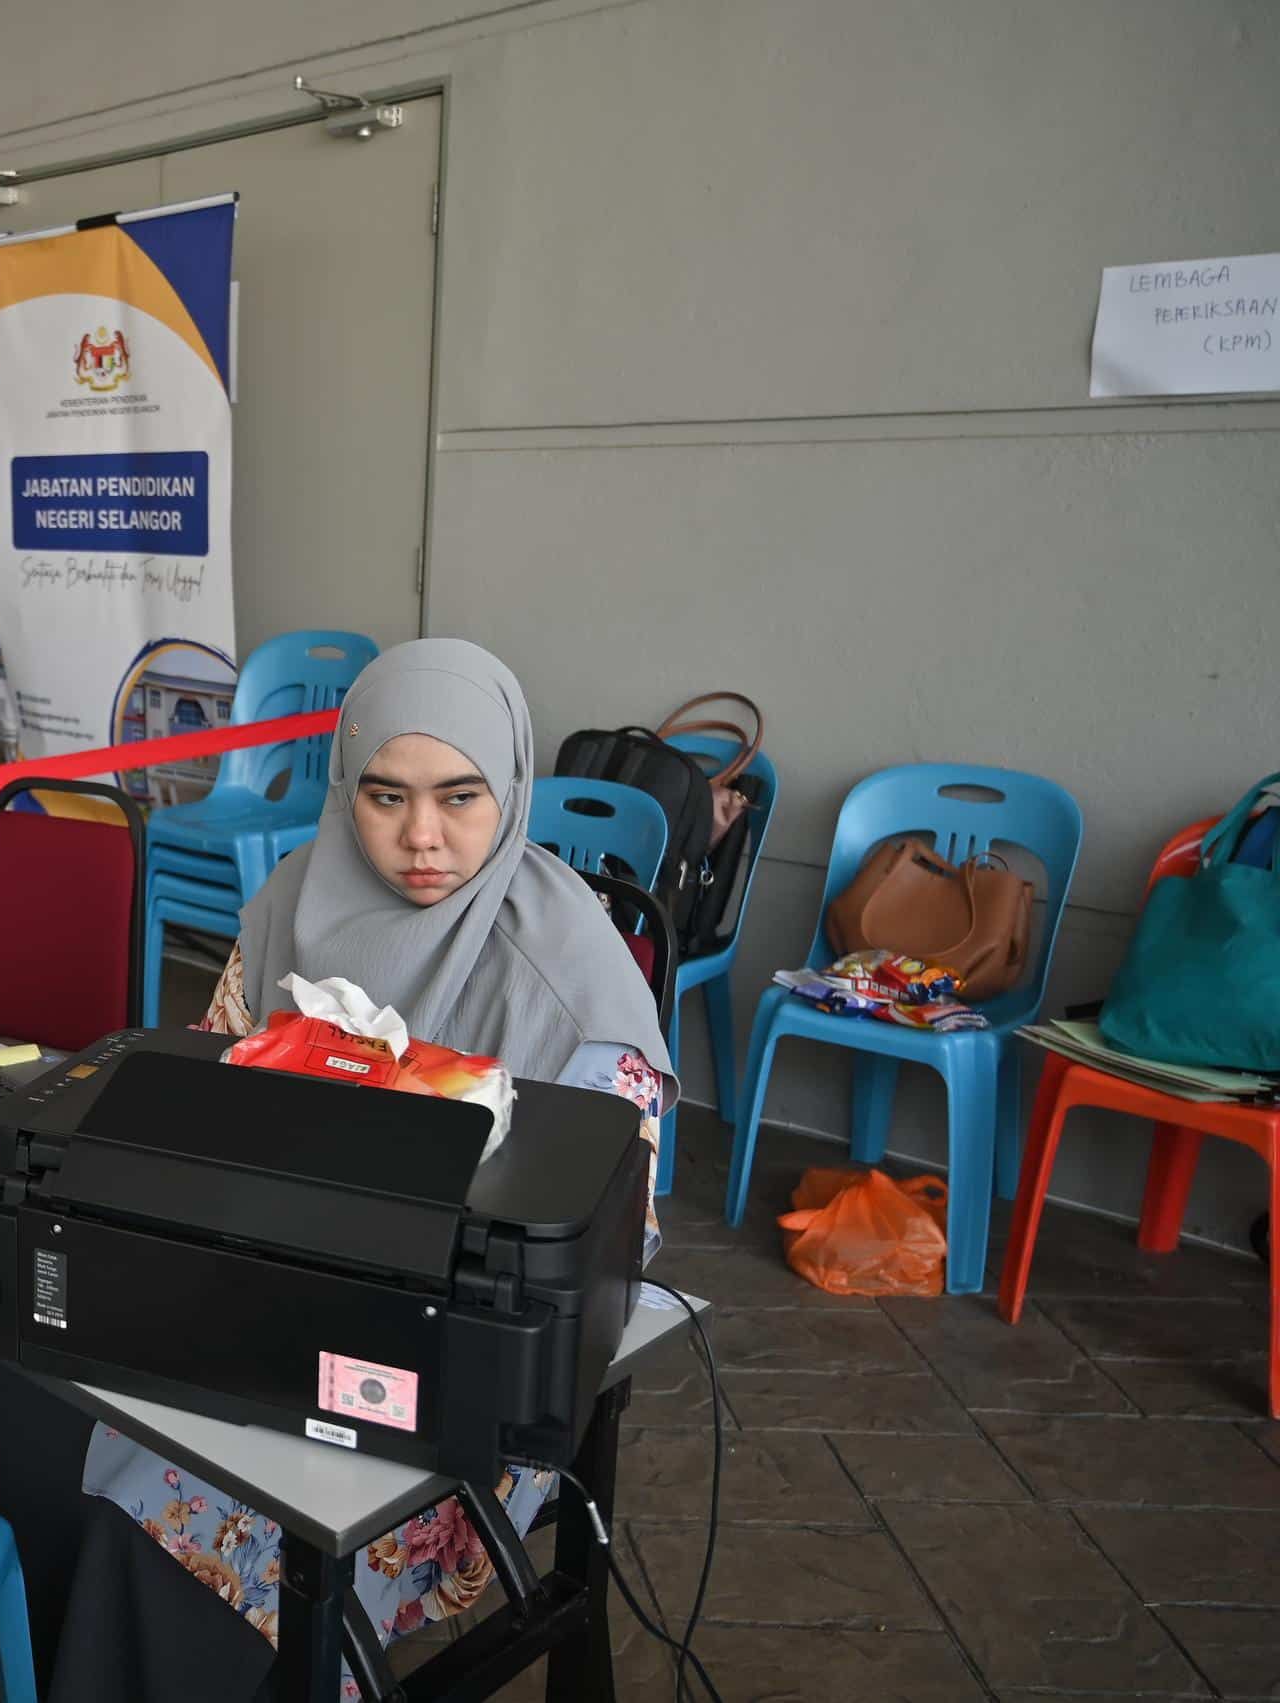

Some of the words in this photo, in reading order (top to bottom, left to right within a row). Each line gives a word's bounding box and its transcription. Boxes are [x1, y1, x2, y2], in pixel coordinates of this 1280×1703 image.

[1129, 265, 1232, 293] LEMBAGA
[1203, 330, 1273, 355] (KPM)
[22, 478, 93, 497] JABATAN
[96, 476, 195, 497] PENDIDIKAN
[35, 509, 94, 529] NEGERI
[97, 509, 182, 531] SELANGOR
